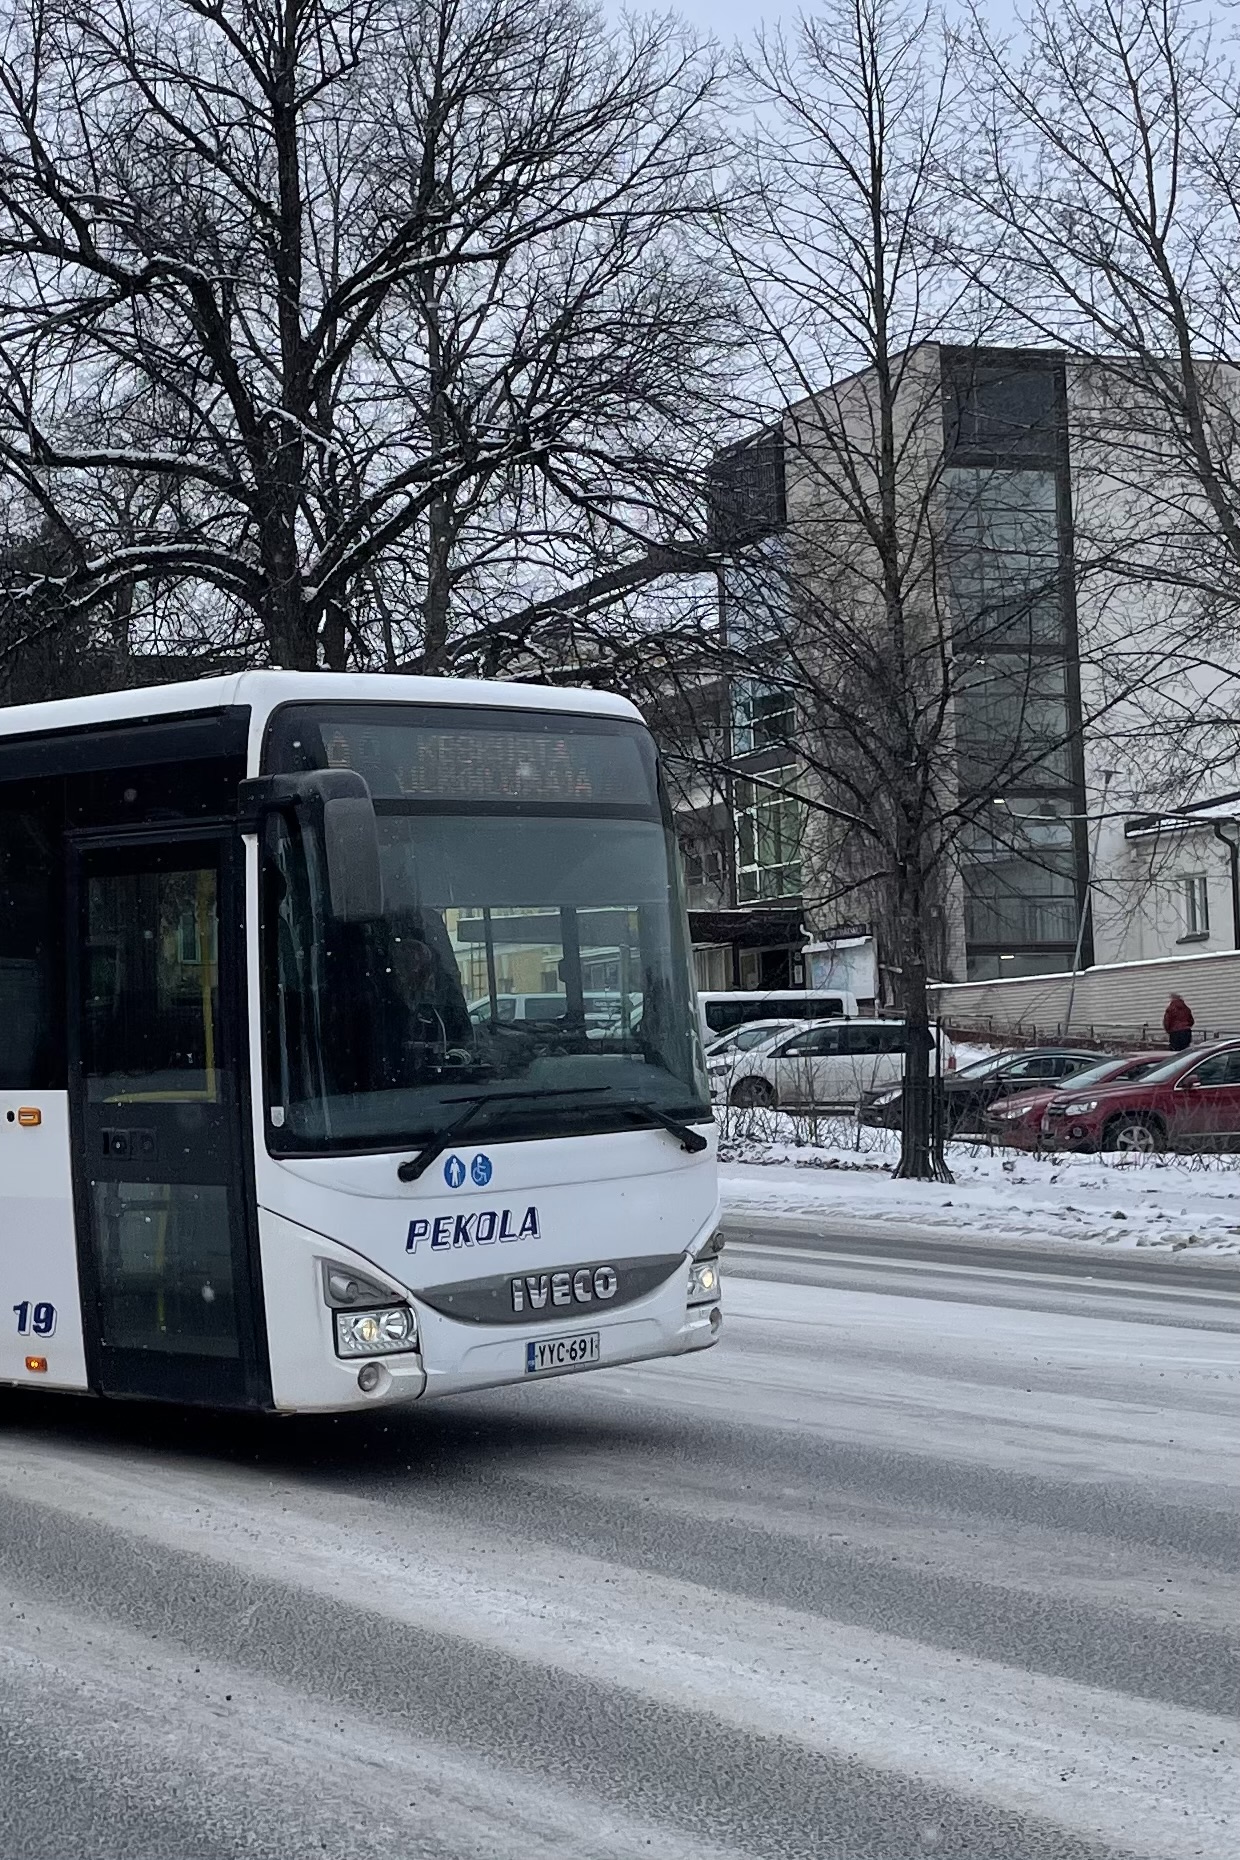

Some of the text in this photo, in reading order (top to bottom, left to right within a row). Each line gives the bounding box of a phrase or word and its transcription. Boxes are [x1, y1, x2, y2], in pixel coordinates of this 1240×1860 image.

[405, 1206, 541, 1254] PEKOLA
[511, 1265, 618, 1312] IVECO
[12, 1301, 58, 1338] 19
[538, 1336, 594, 1367] YYC-691
